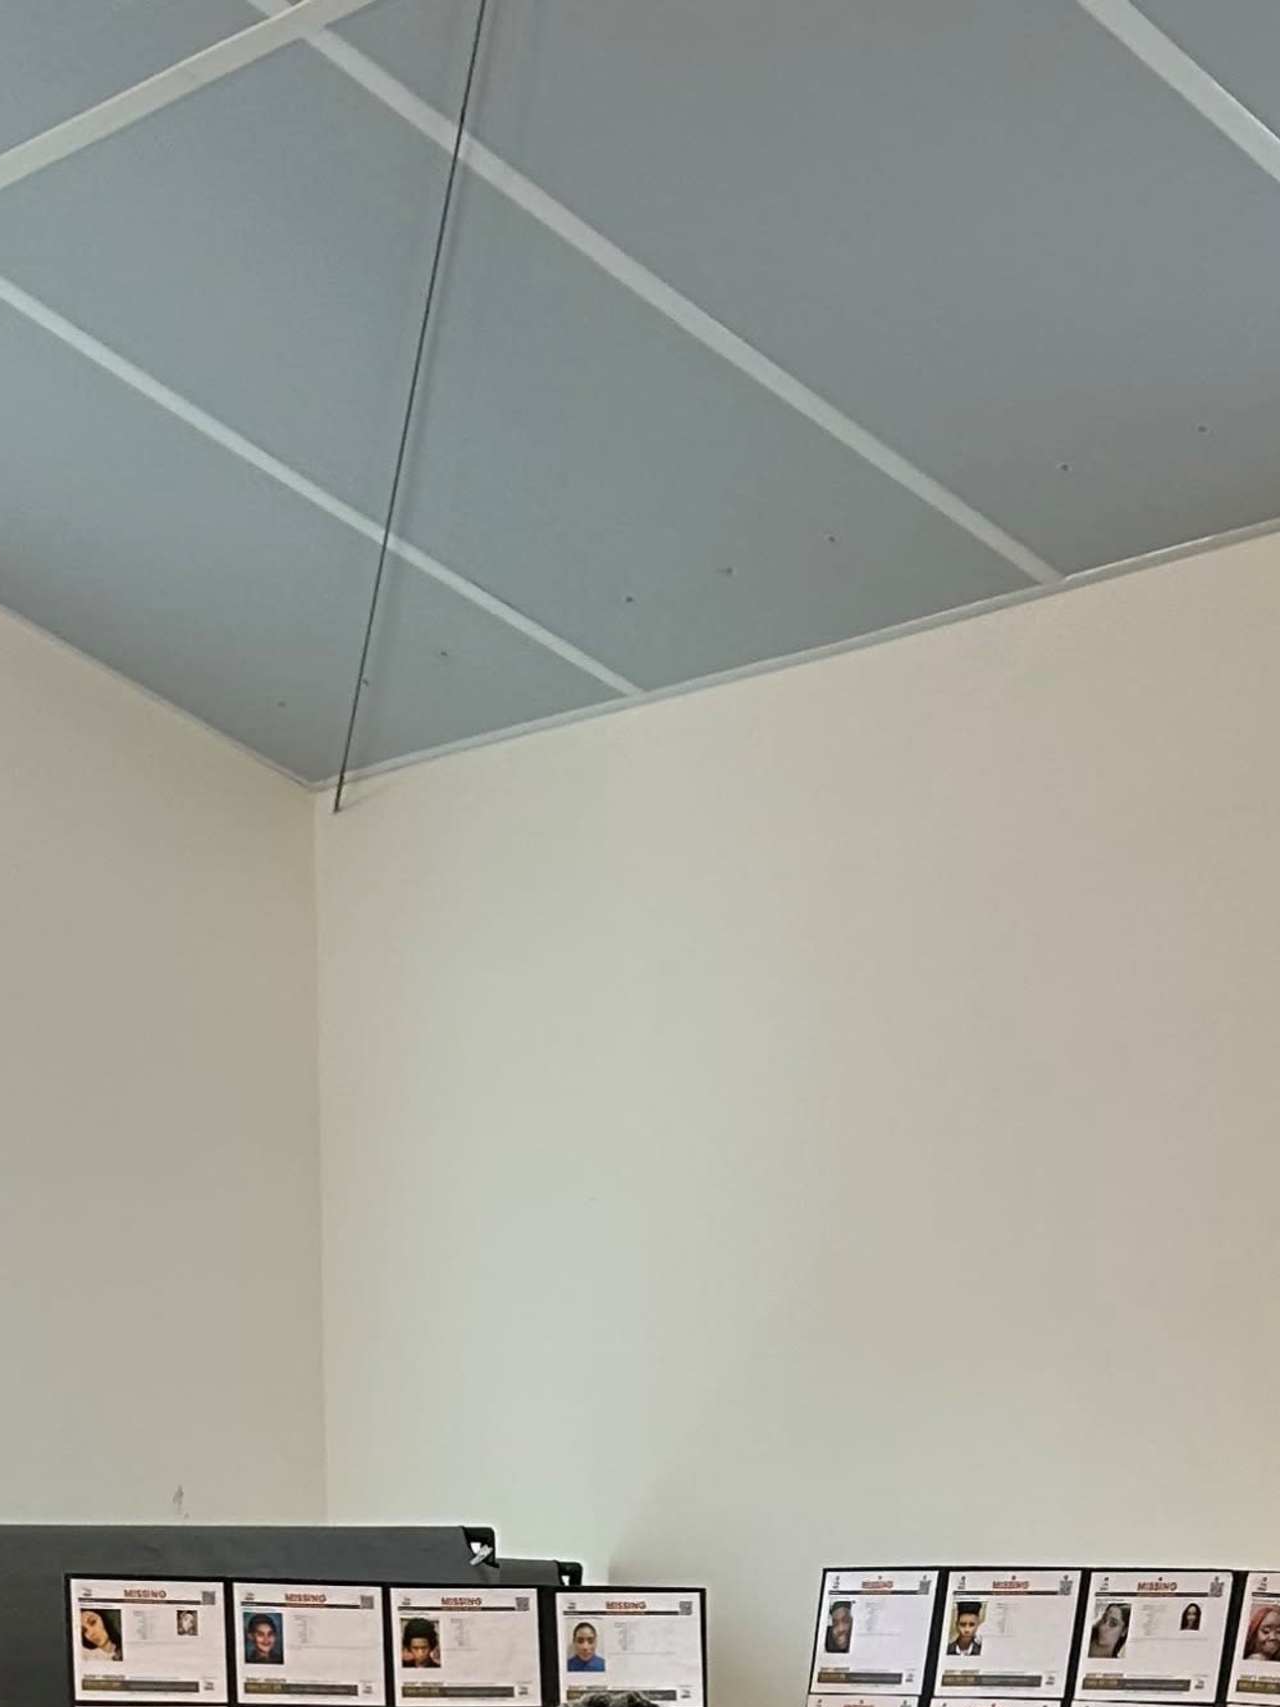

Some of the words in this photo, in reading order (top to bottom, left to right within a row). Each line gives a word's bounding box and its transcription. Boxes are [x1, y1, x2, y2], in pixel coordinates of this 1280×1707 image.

[124, 1589, 167, 1599] MISSING
[285, 1593, 327, 1602] MISSING
[441, 1597, 481, 1607] MISSING
[606, 1601, 646, 1611] MISSING
